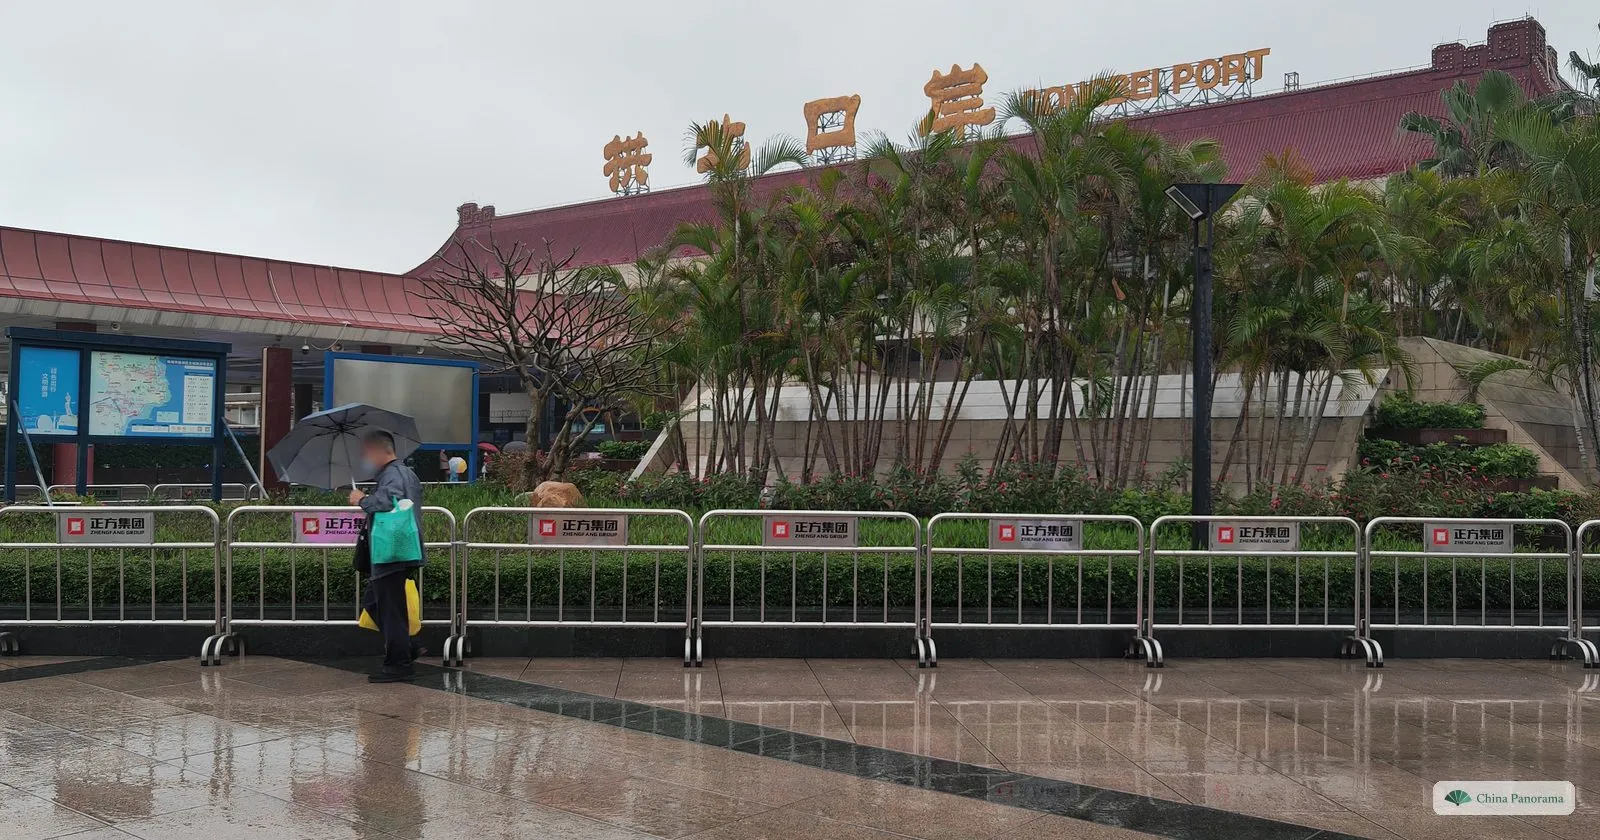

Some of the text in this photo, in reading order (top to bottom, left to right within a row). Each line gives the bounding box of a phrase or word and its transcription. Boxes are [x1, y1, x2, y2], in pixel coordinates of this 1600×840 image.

[1172, 48, 1271, 94] PORT
[90, 517, 145, 530] 正方集团
[325, 517, 366, 530] 正方集
[562, 519, 618, 531] 正方集团
[794, 521, 848, 534] 正方集团
[1020, 525, 1073, 537] 正方集团
[1239, 526, 1290, 538] 正方集团
[1453, 528, 1504, 540] 正方集团
